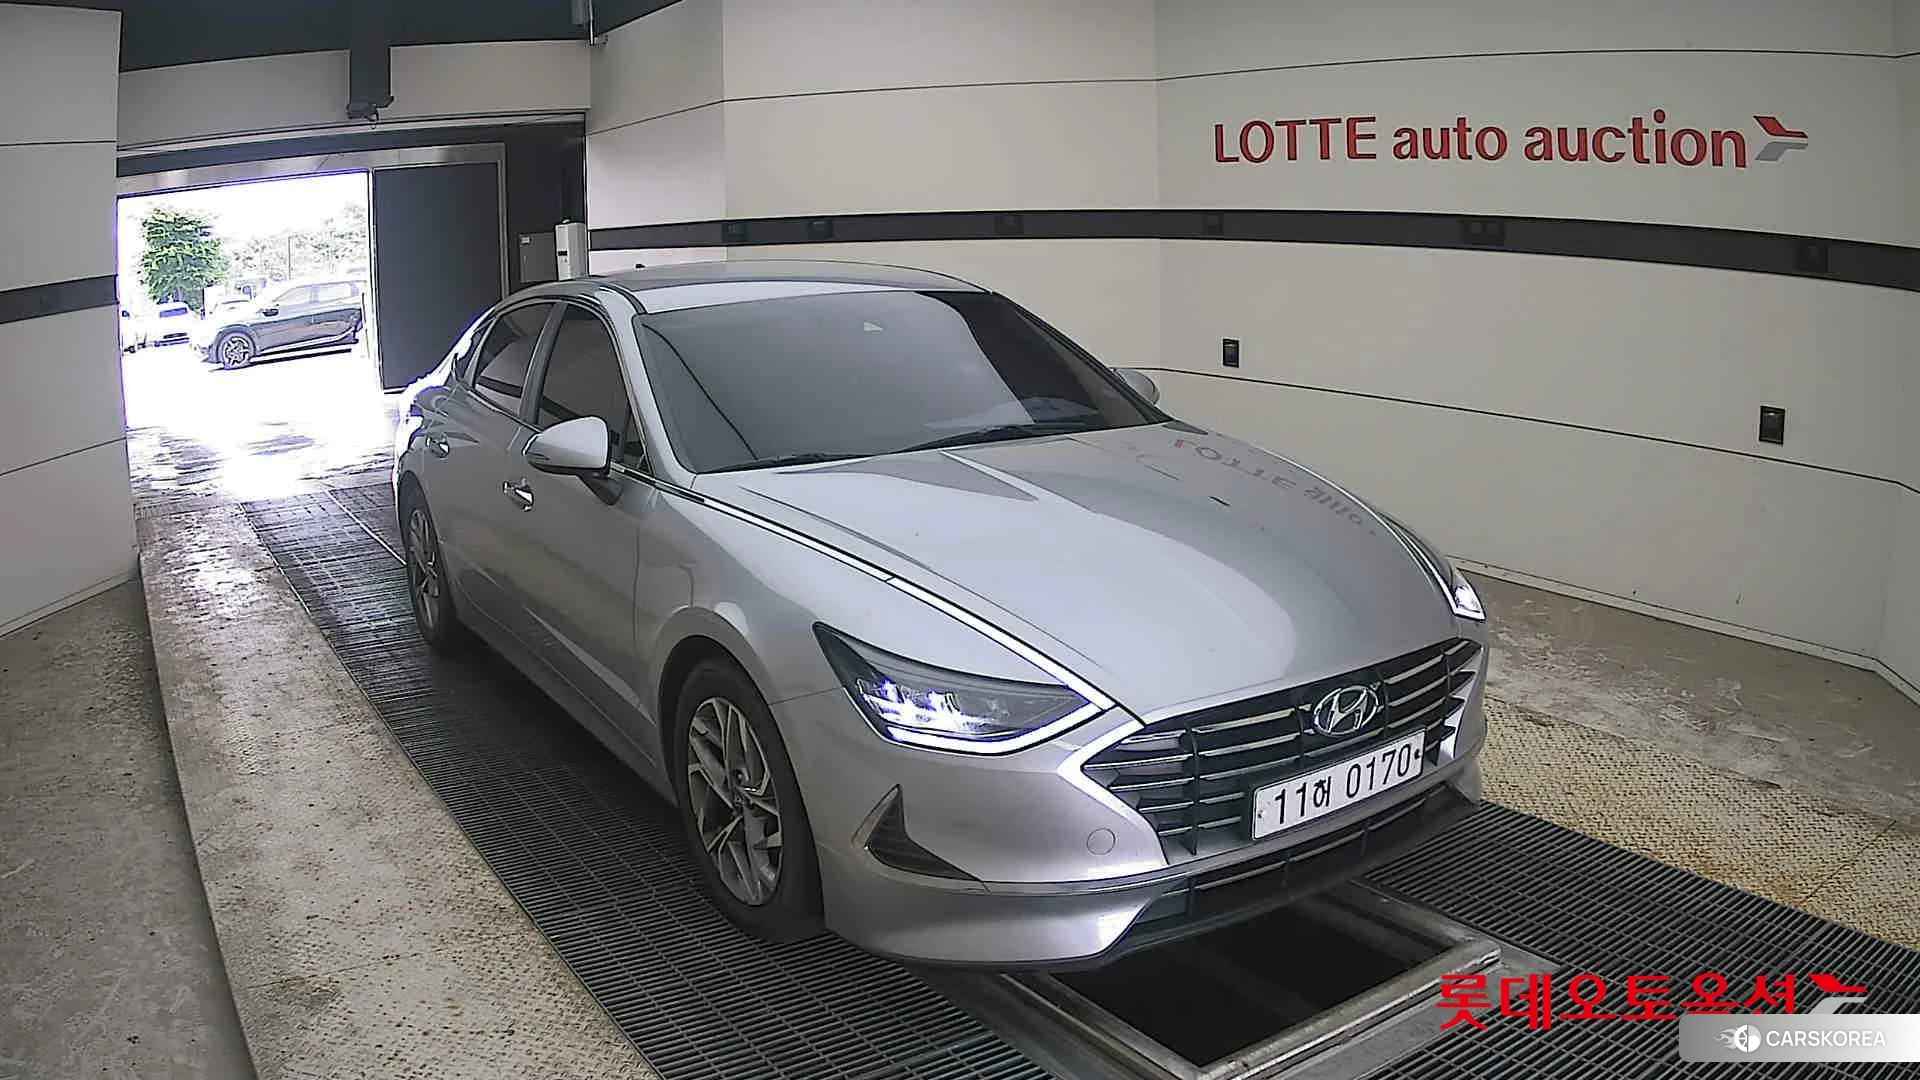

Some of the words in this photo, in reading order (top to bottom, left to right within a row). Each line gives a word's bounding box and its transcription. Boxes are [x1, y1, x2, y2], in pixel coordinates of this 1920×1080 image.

[1215, 116, 1376, 163] LOTTE
[1392, 117, 1508, 160] auto
[1523, 109, 1746, 168] auction
[1274, 775, 1332, 825] 11허
[1346, 743, 1412, 799] 0170
